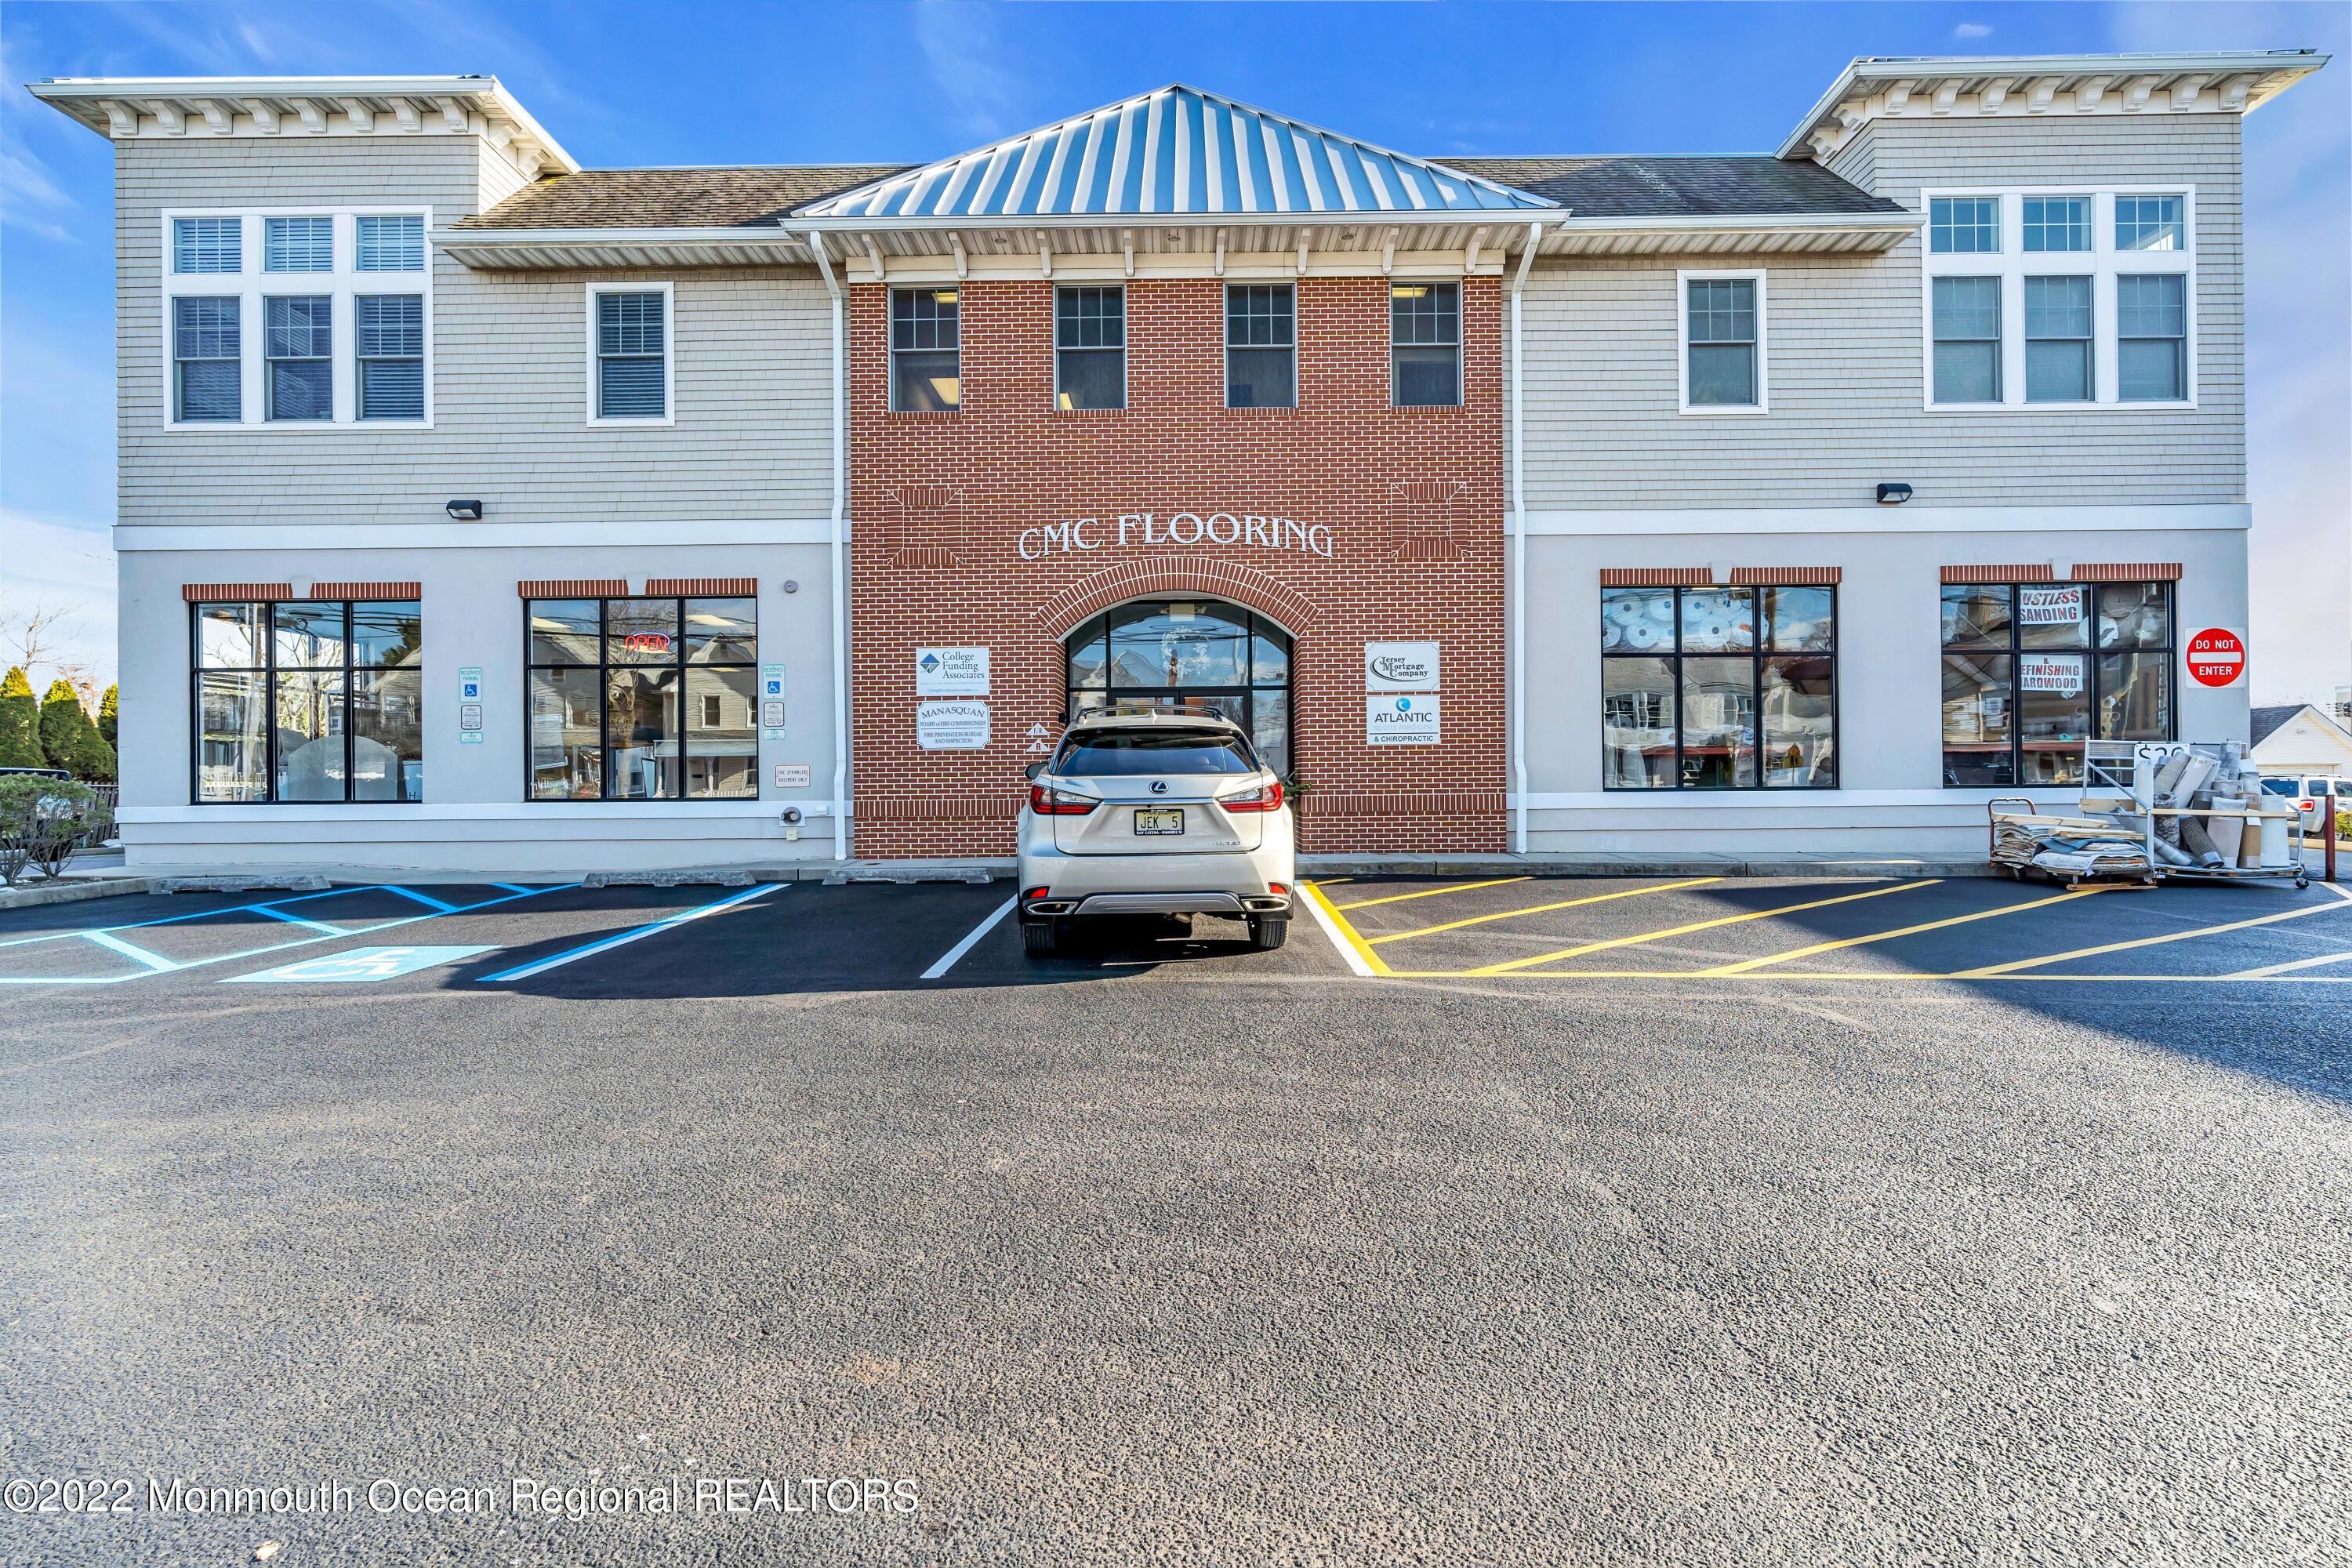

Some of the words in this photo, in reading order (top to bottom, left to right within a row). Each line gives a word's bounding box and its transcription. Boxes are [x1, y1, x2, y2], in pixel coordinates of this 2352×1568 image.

[1019, 517, 1102, 560] CMC
[1116, 512, 1334, 557] FLOORING
[2020, 590, 2080, 605] USTLESS
[2020, 606, 2077, 621] SANDING
[625, 635, 667, 652] OPEN
[2196, 640, 2210, 649] DO
[2215, 640, 2234, 649] NOT
[942, 652, 975, 663] College
[942, 660, 978, 672] Funding
[2020, 665, 2080, 676] EFINISHING
[2199, 666, 2233, 676] ENTER
[942, 670, 985, 679] Associates
[1389, 669, 1428, 677] Company
[2021, 677, 2078, 688] ARDWOOD
[921, 706, 985, 719] MANASQUAN
[1374, 712, 1433, 723] ATLANTIC
[1141, 816, 1159, 829] JEK
[1172, 816, 1178, 828] 5
